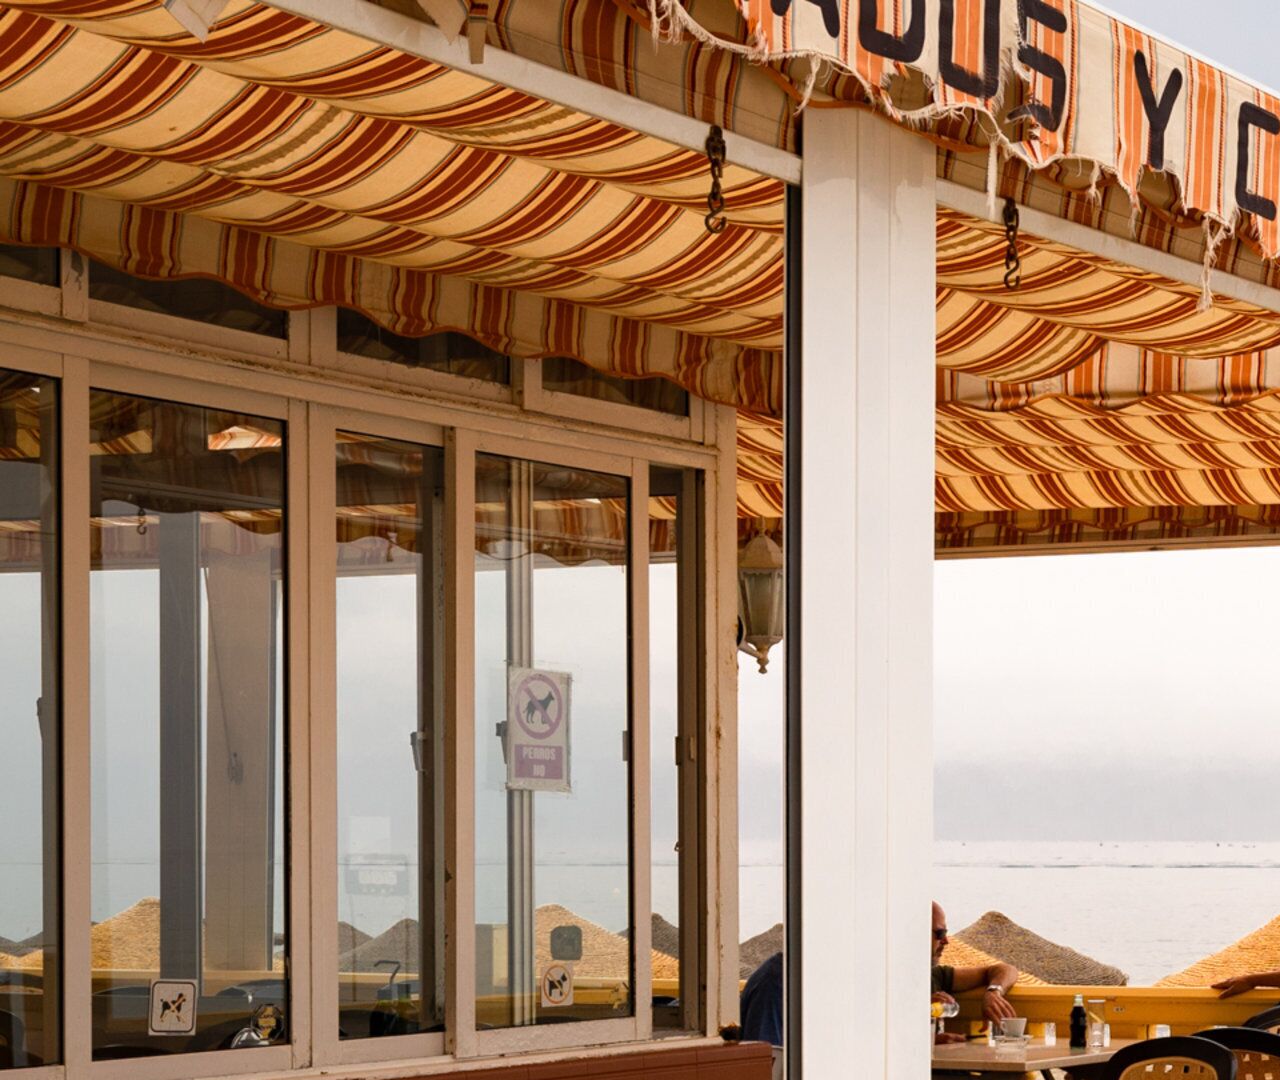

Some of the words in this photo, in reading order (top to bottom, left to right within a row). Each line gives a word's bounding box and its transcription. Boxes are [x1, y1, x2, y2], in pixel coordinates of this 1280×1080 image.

[1134, 49, 1183, 170] Y
[522, 746, 557, 760] PERROS
[533, 764, 546, 777] NO
